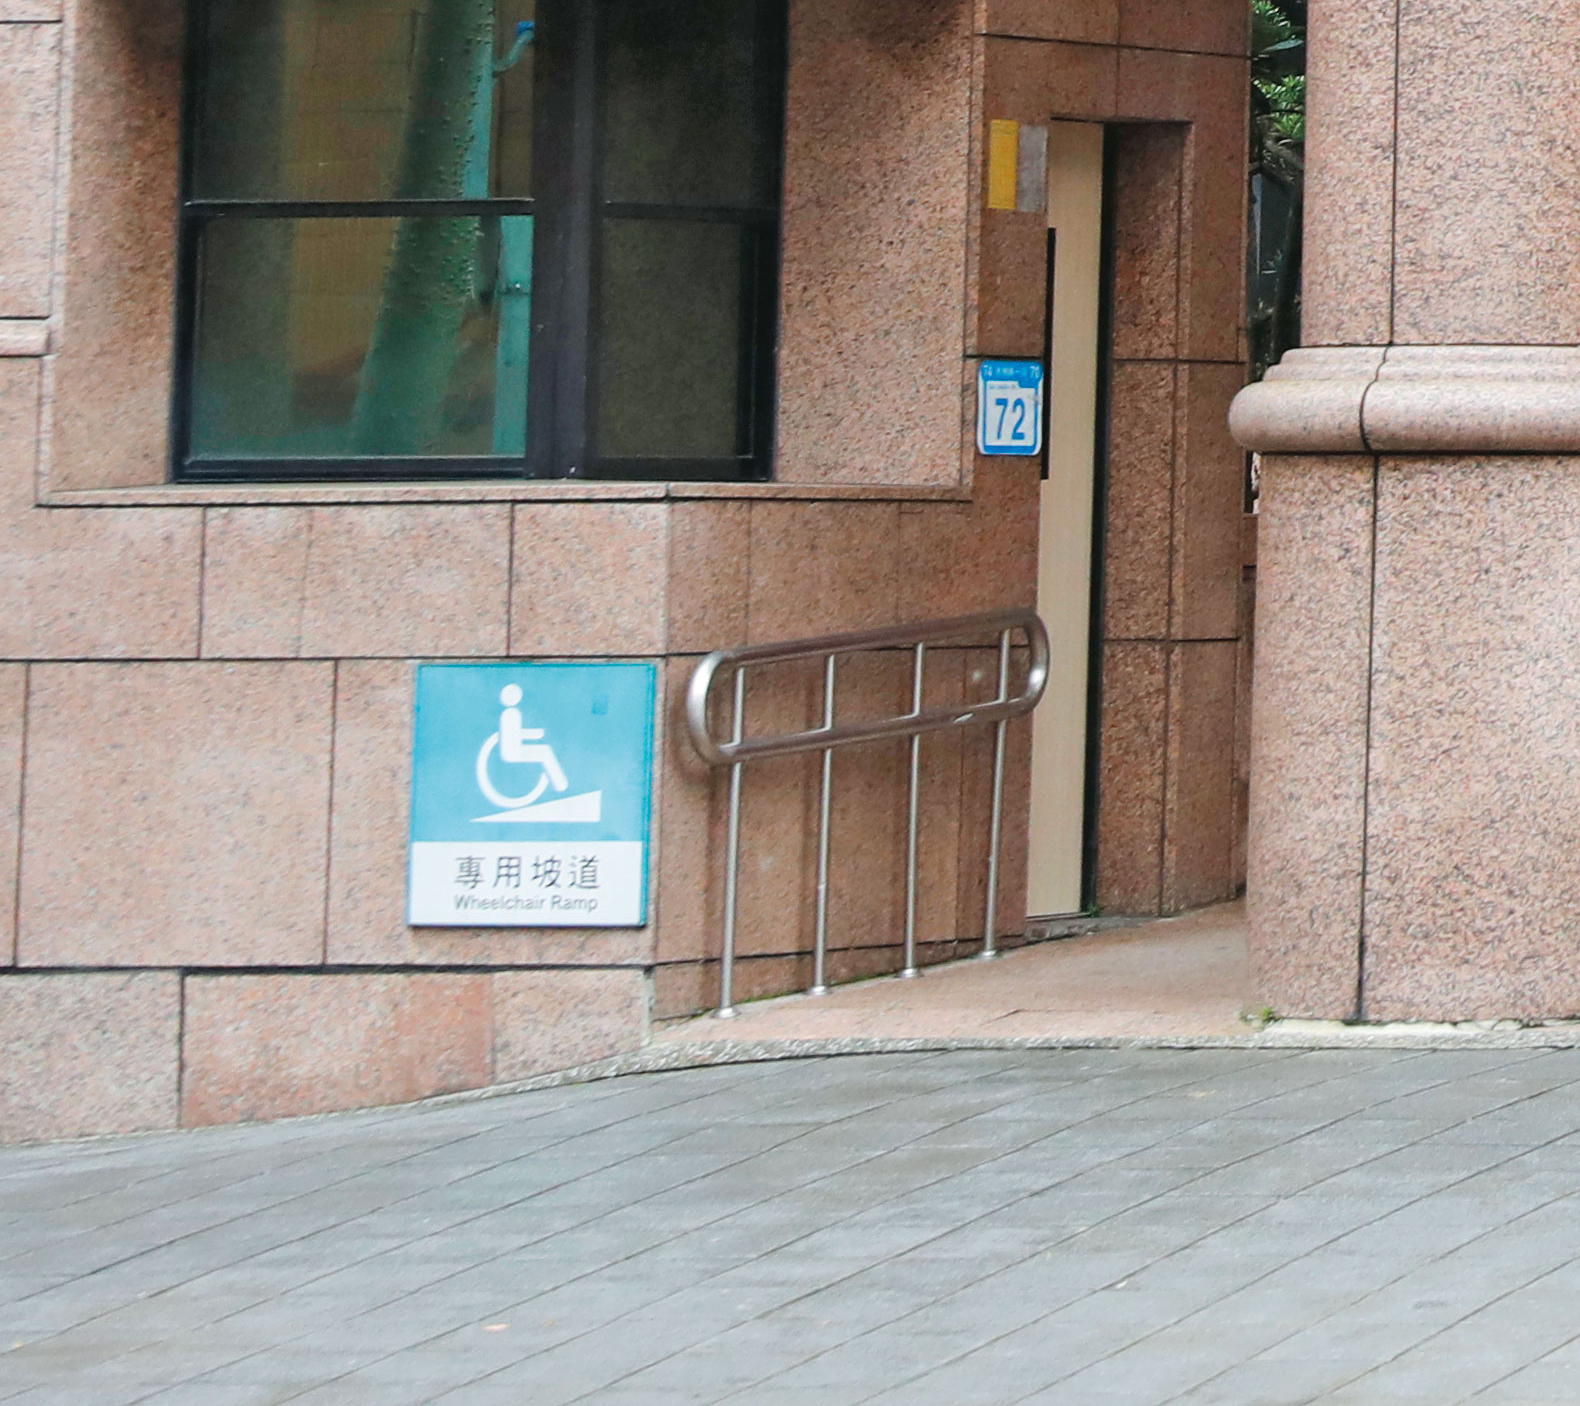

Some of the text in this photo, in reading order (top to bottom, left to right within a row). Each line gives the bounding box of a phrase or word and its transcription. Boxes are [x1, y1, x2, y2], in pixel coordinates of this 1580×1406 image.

[994, 397, 1026, 441] 72
[454, 854, 601, 890] 專用坡道
[455, 893, 599, 913] Wheelchair Ramp
